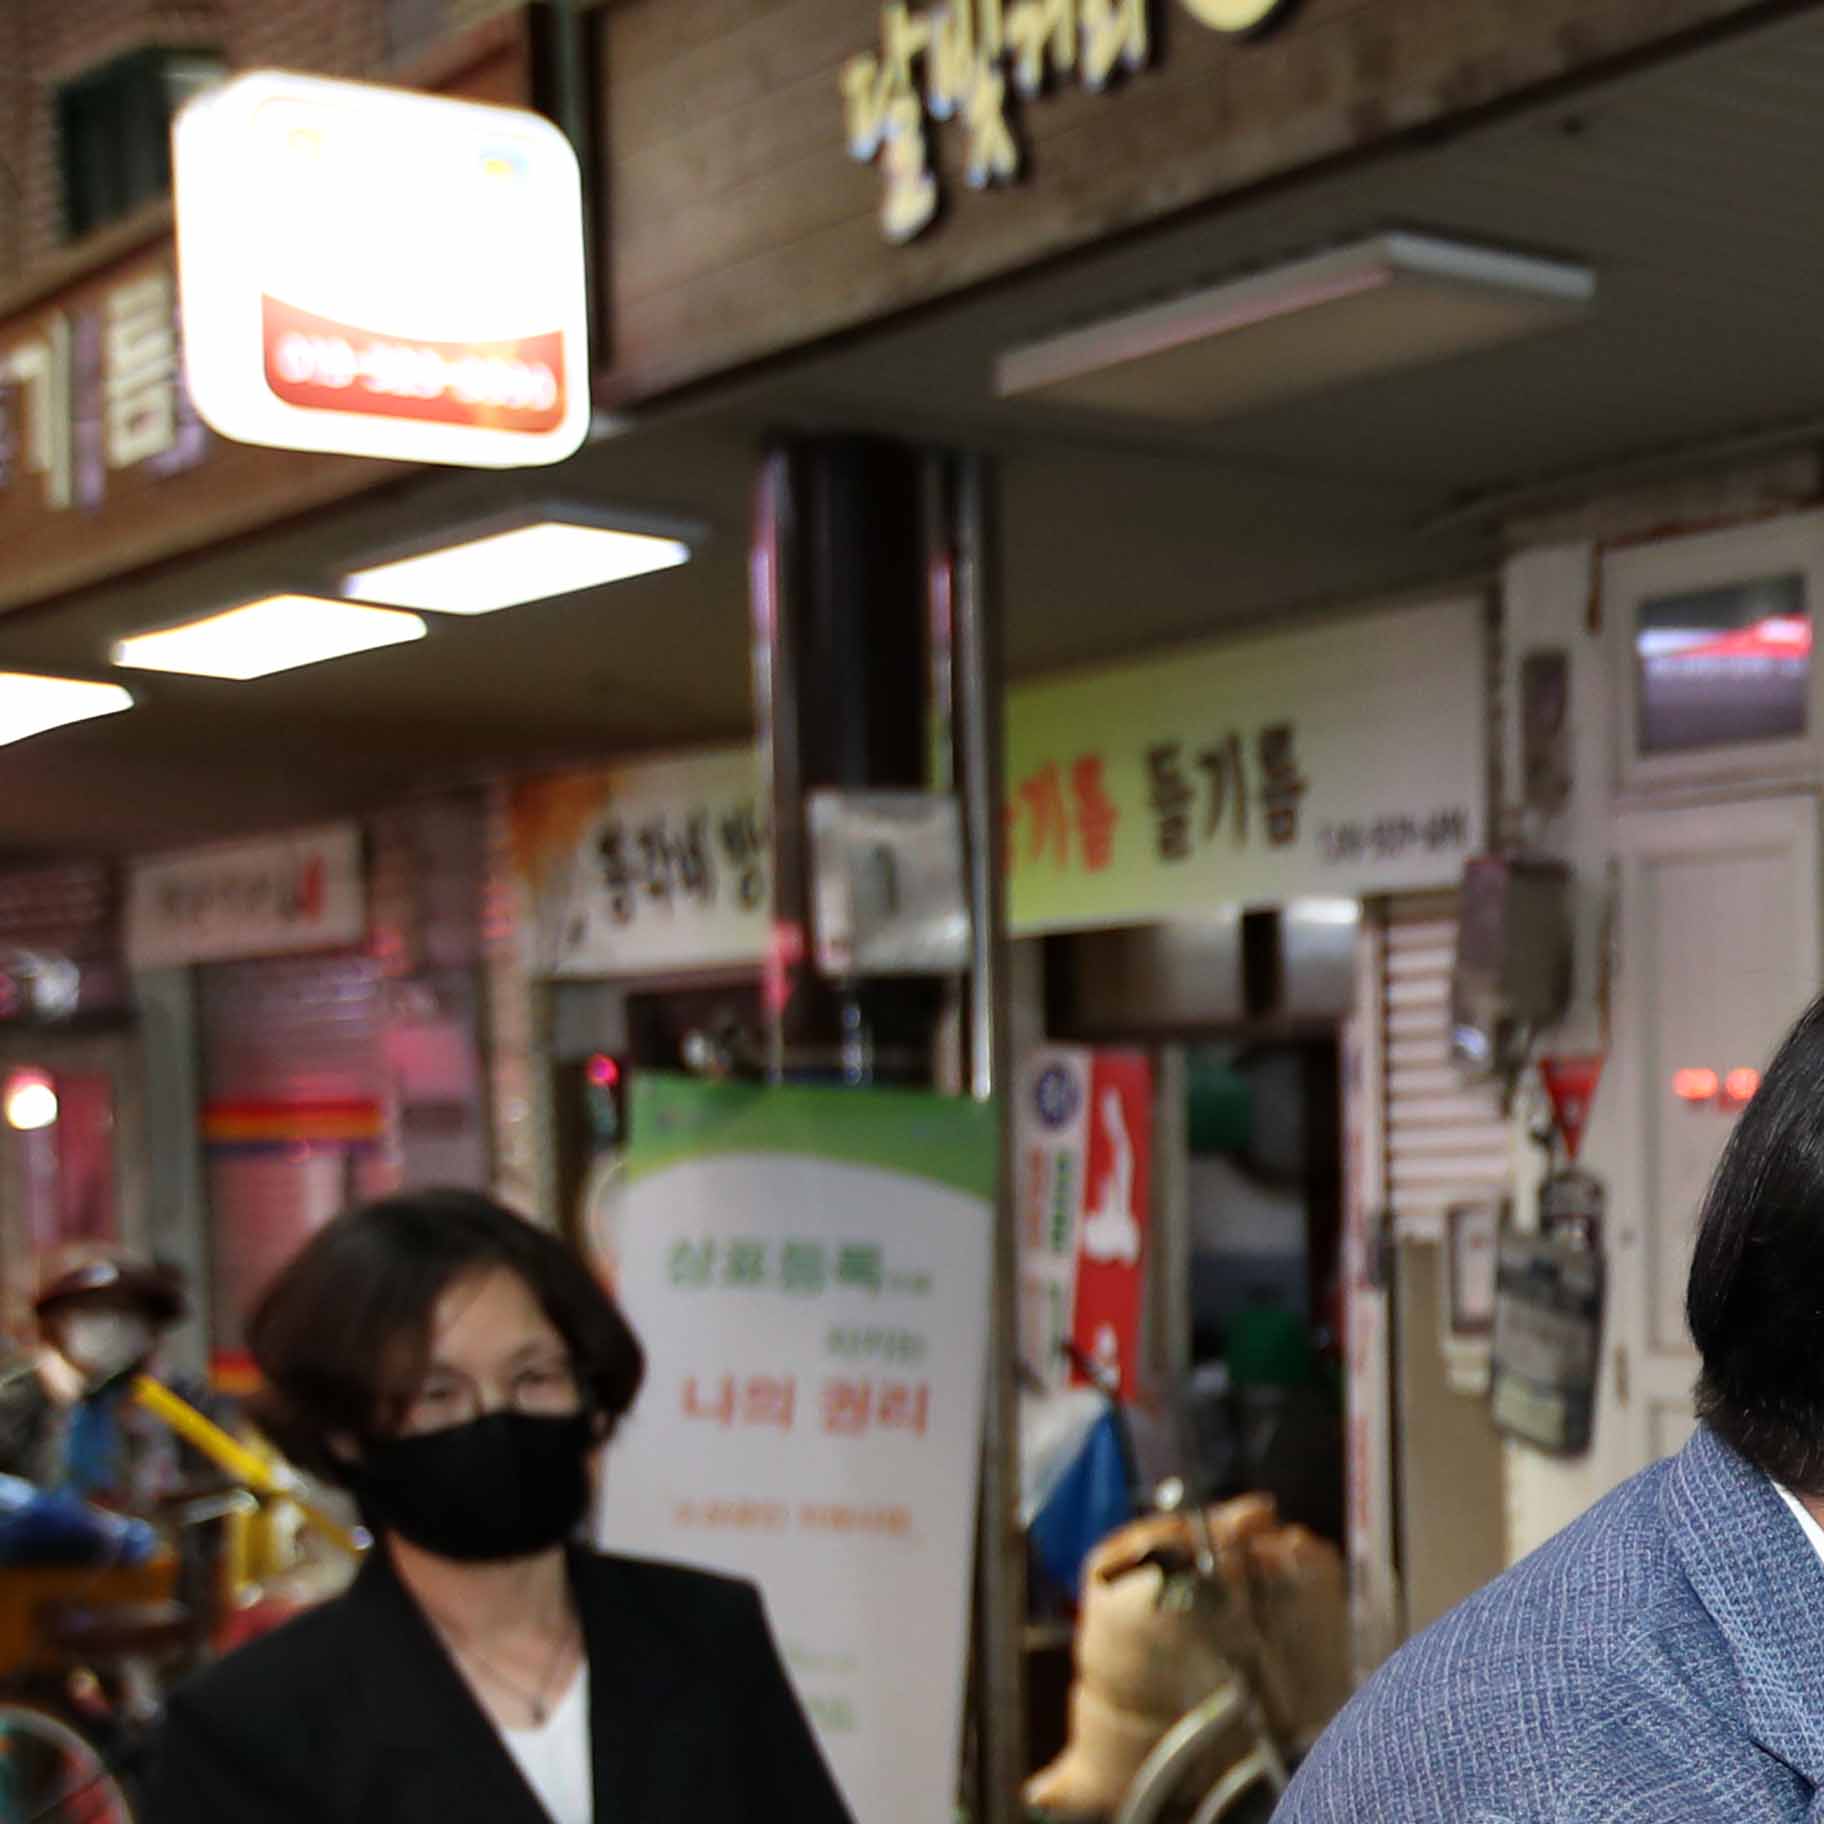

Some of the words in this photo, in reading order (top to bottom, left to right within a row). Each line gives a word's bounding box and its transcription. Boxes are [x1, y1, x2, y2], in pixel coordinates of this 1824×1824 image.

[1000, 743, 1117, 873] 기름
[1146, 720, 1307, 862] 들기름
[679, 1373, 798, 1435] 나의
[818, 1374, 931, 1439] 권리
